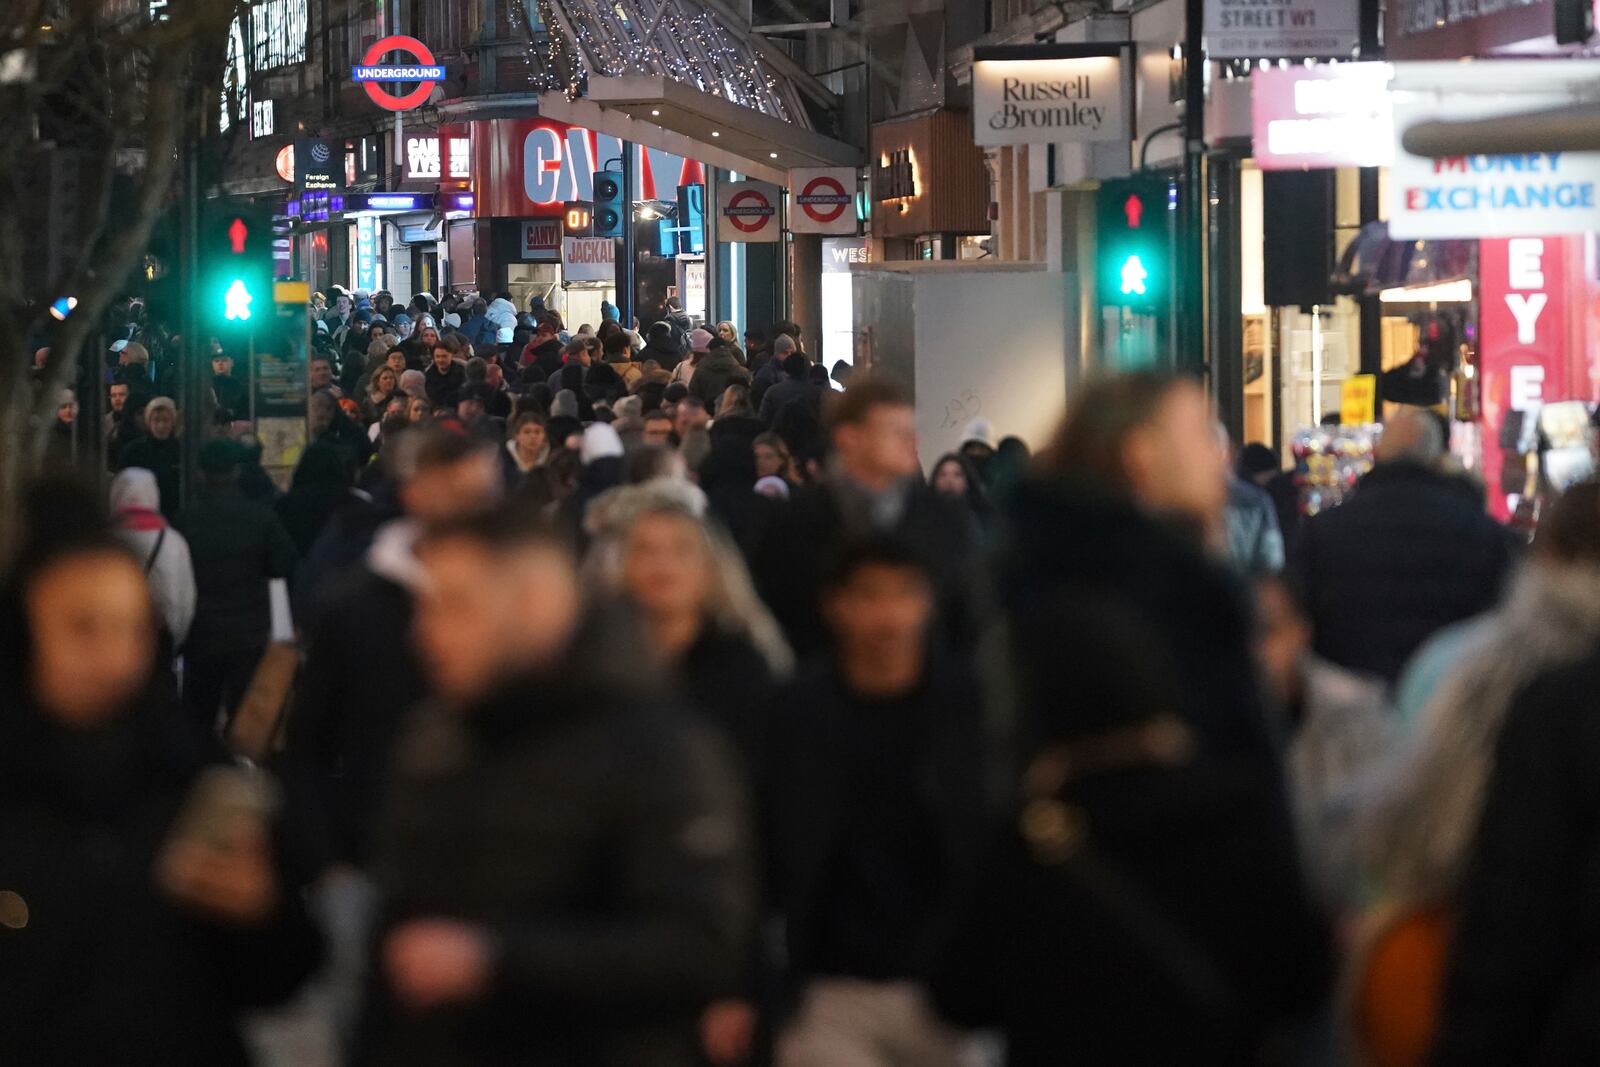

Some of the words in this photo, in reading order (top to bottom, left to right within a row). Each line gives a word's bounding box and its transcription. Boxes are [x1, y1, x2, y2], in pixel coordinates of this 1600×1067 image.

[1220, 9, 1284, 28] STREET
[1289, 9, 1316, 27] W1
[357, 68, 441, 78] UNDERGROUND
[1003, 75, 1091, 102] Russell
[989, 102, 1107, 131] Bromley
[305, 174, 330, 182] Foreign
[305, 182, 336, 190] Exchange
[1406, 183, 1594, 211] EXCHANGE
[568, 210, 589, 228] 01
[726, 207, 773, 215] UNDERGROUND
[831, 247, 872, 264] WES
